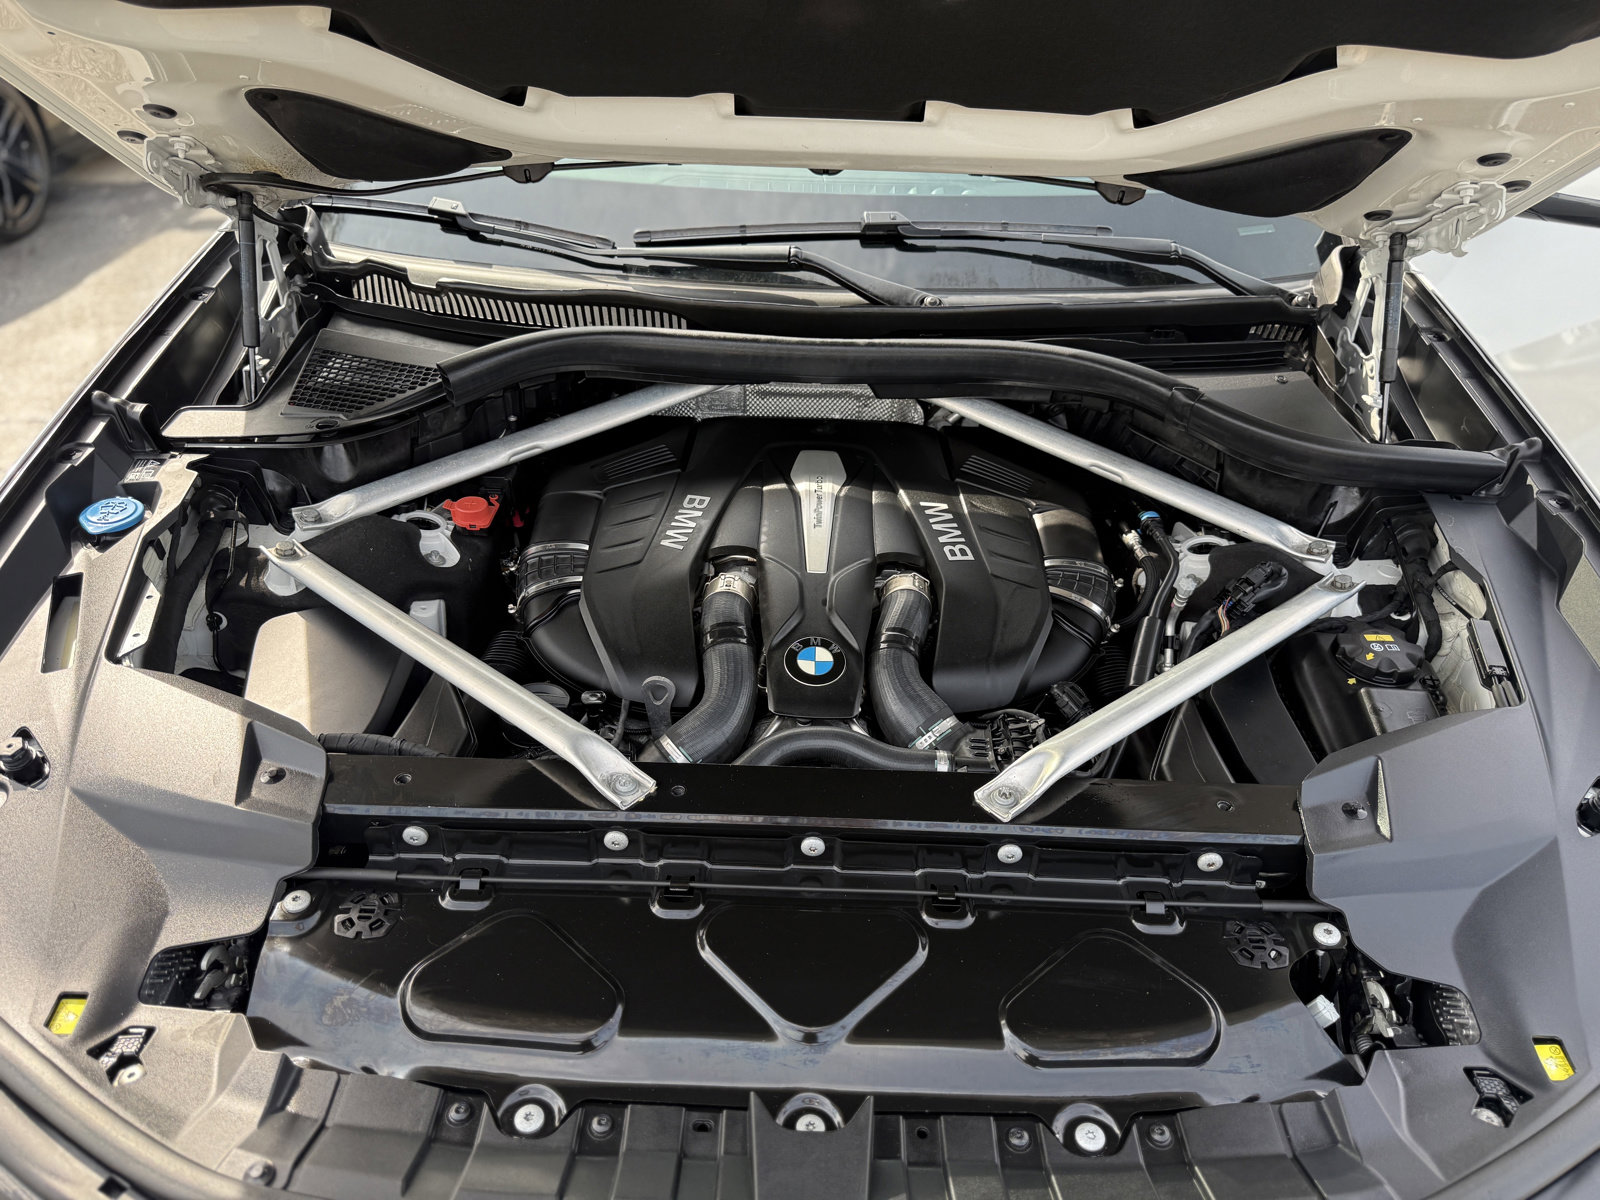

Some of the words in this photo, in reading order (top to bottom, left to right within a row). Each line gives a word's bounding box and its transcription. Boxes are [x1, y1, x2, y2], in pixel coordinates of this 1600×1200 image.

[815, 475, 823, 493] Turbo
[660, 494, 711, 550] BMW
[814, 493, 823, 529] TwinPower
[919, 501, 975, 561] BMW
[791, 637, 841, 654] BMW
